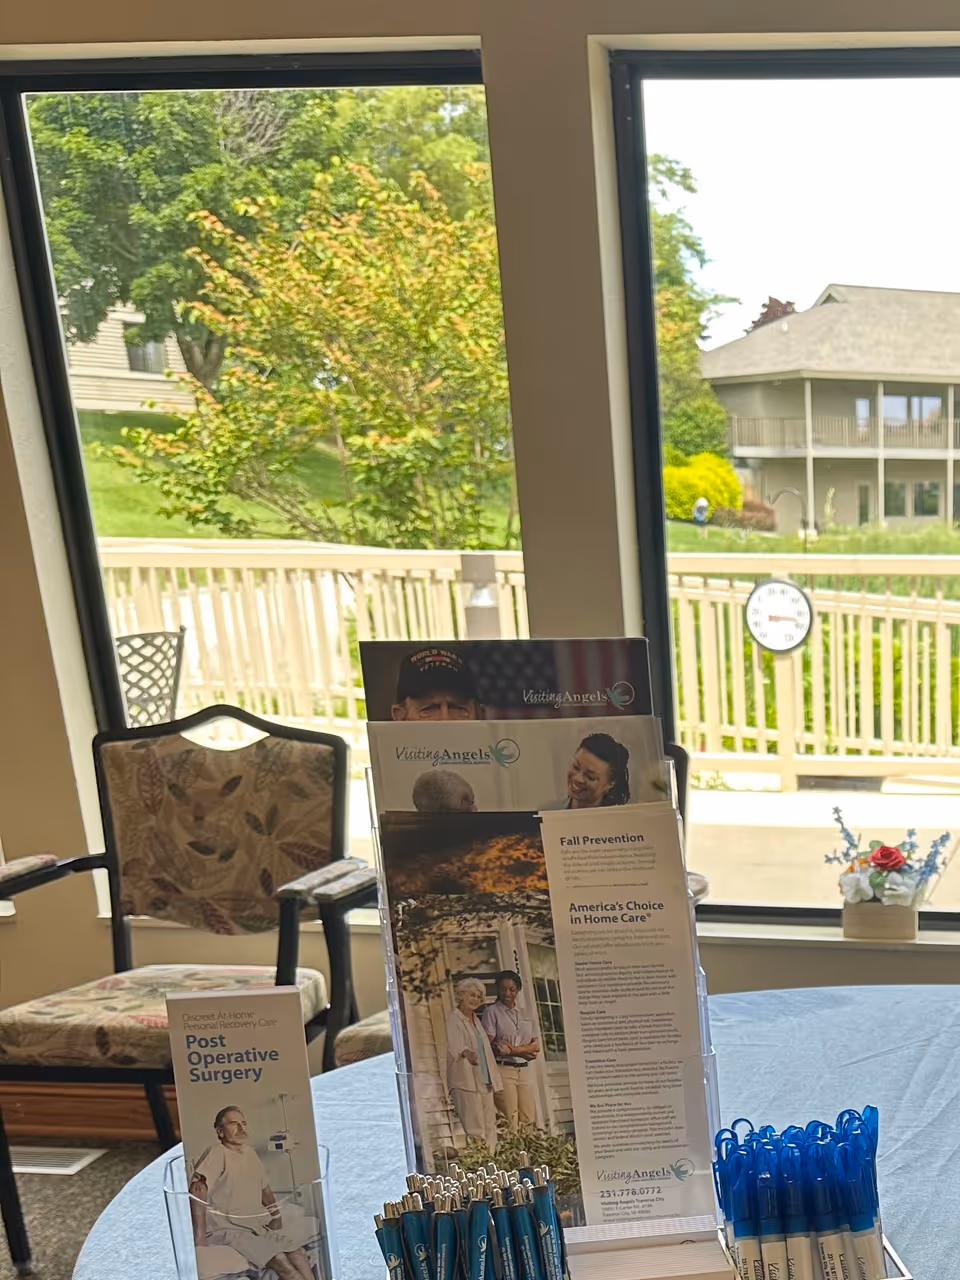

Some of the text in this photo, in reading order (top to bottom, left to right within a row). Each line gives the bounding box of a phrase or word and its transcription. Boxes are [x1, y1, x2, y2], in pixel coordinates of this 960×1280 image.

[410, 649, 438, 664] WORLD
[560, 833, 645, 847] Fall Prevention
[569, 900, 664, 913] America's Choice
[570, 914, 581, 925] in
[584, 913, 619, 924] Home
[183, 1018, 277, 1031] Personal Recovery Care
[186, 1034, 226, 1049] Post
[188, 1048, 279, 1068] Operative
[190, 1067, 263, 1084] Surgery
